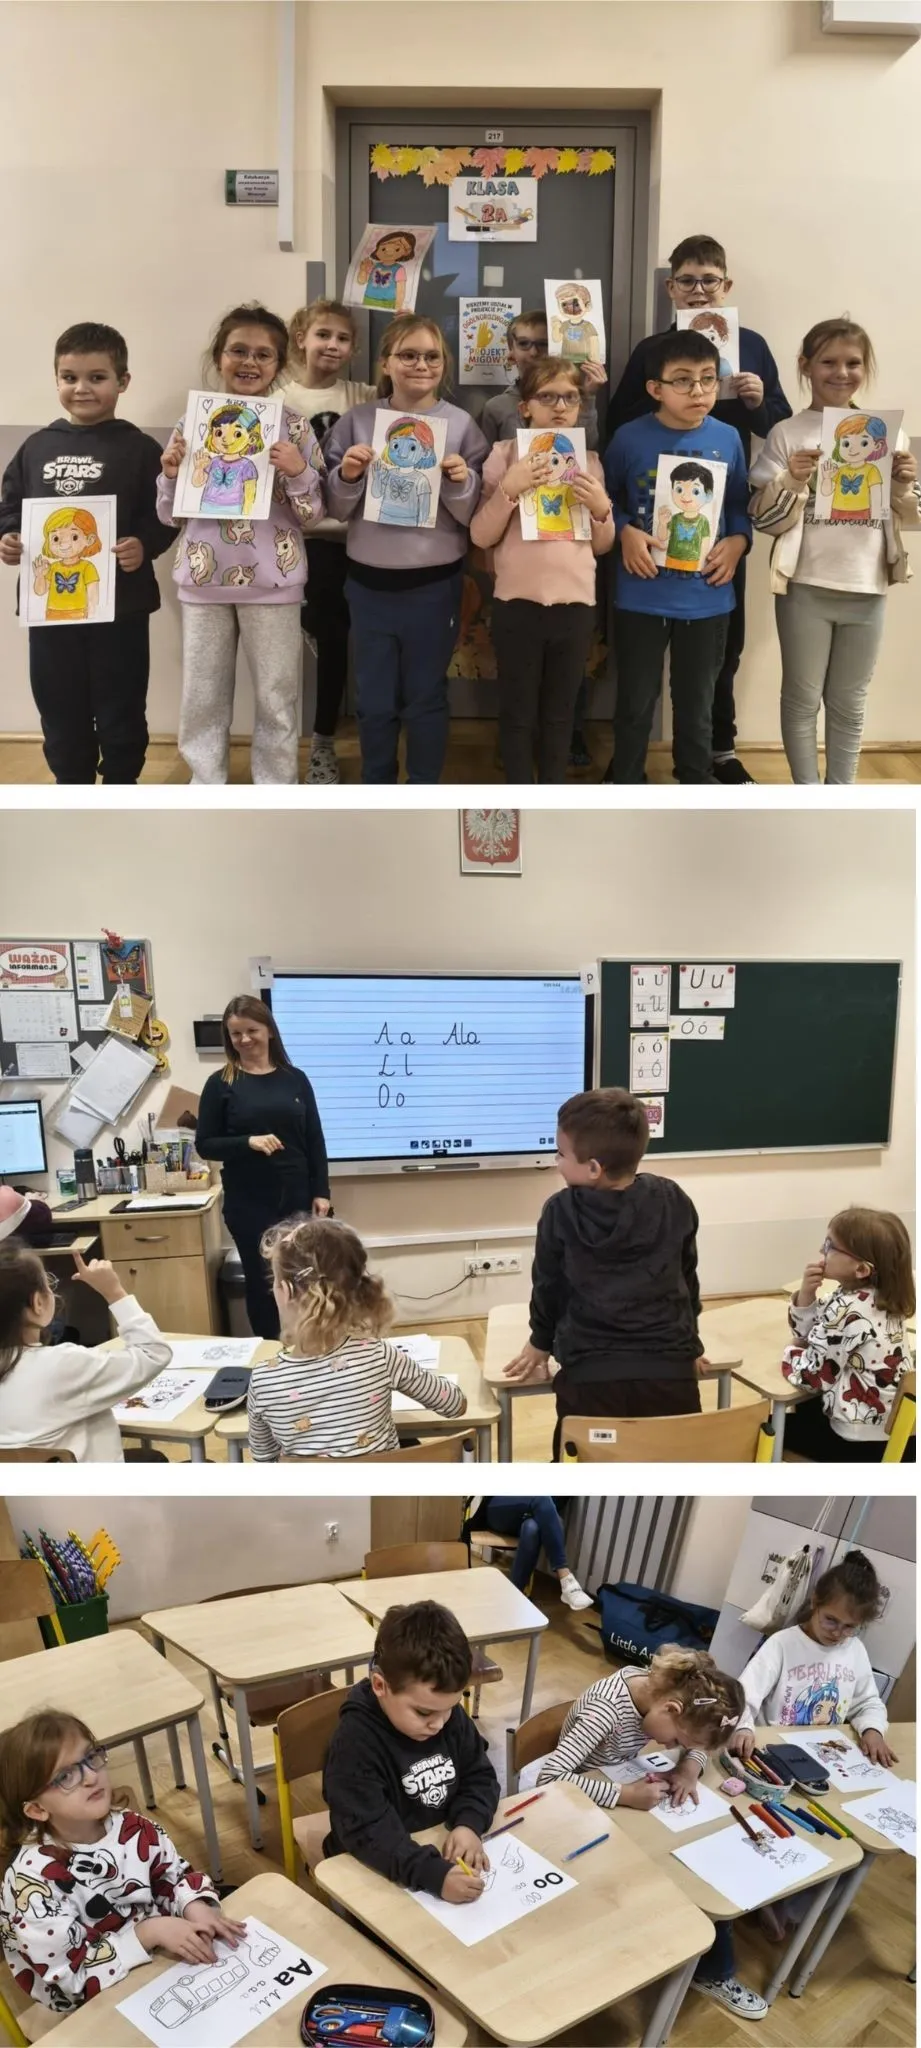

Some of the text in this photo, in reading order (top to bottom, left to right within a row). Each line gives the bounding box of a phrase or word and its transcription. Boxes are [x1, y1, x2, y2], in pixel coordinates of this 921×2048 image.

[466, 181, 520, 196] KLASA
[481, 203, 508, 222] 2A
[470, 348, 507, 356] PROJEKT
[57, 456, 95, 464] BRAWL
[43, 462, 104, 480] STARS
[9, 951, 57, 964] WAŻNE
[258, 965, 266, 977] L
[587, 973, 594, 984] P
[374, 1021, 480, 1045] A a Ala
[379, 1054, 395, 1076] L
[379, 1083, 405, 1108] O o
[610, 1632, 657, 1660] Little Ar
[787, 1662, 856, 1682] FEARLESS
[411, 1754, 446, 1776] BRAWL
[401, 1759, 456, 1795] STARS
[273, 1958, 313, 1986] Aa
